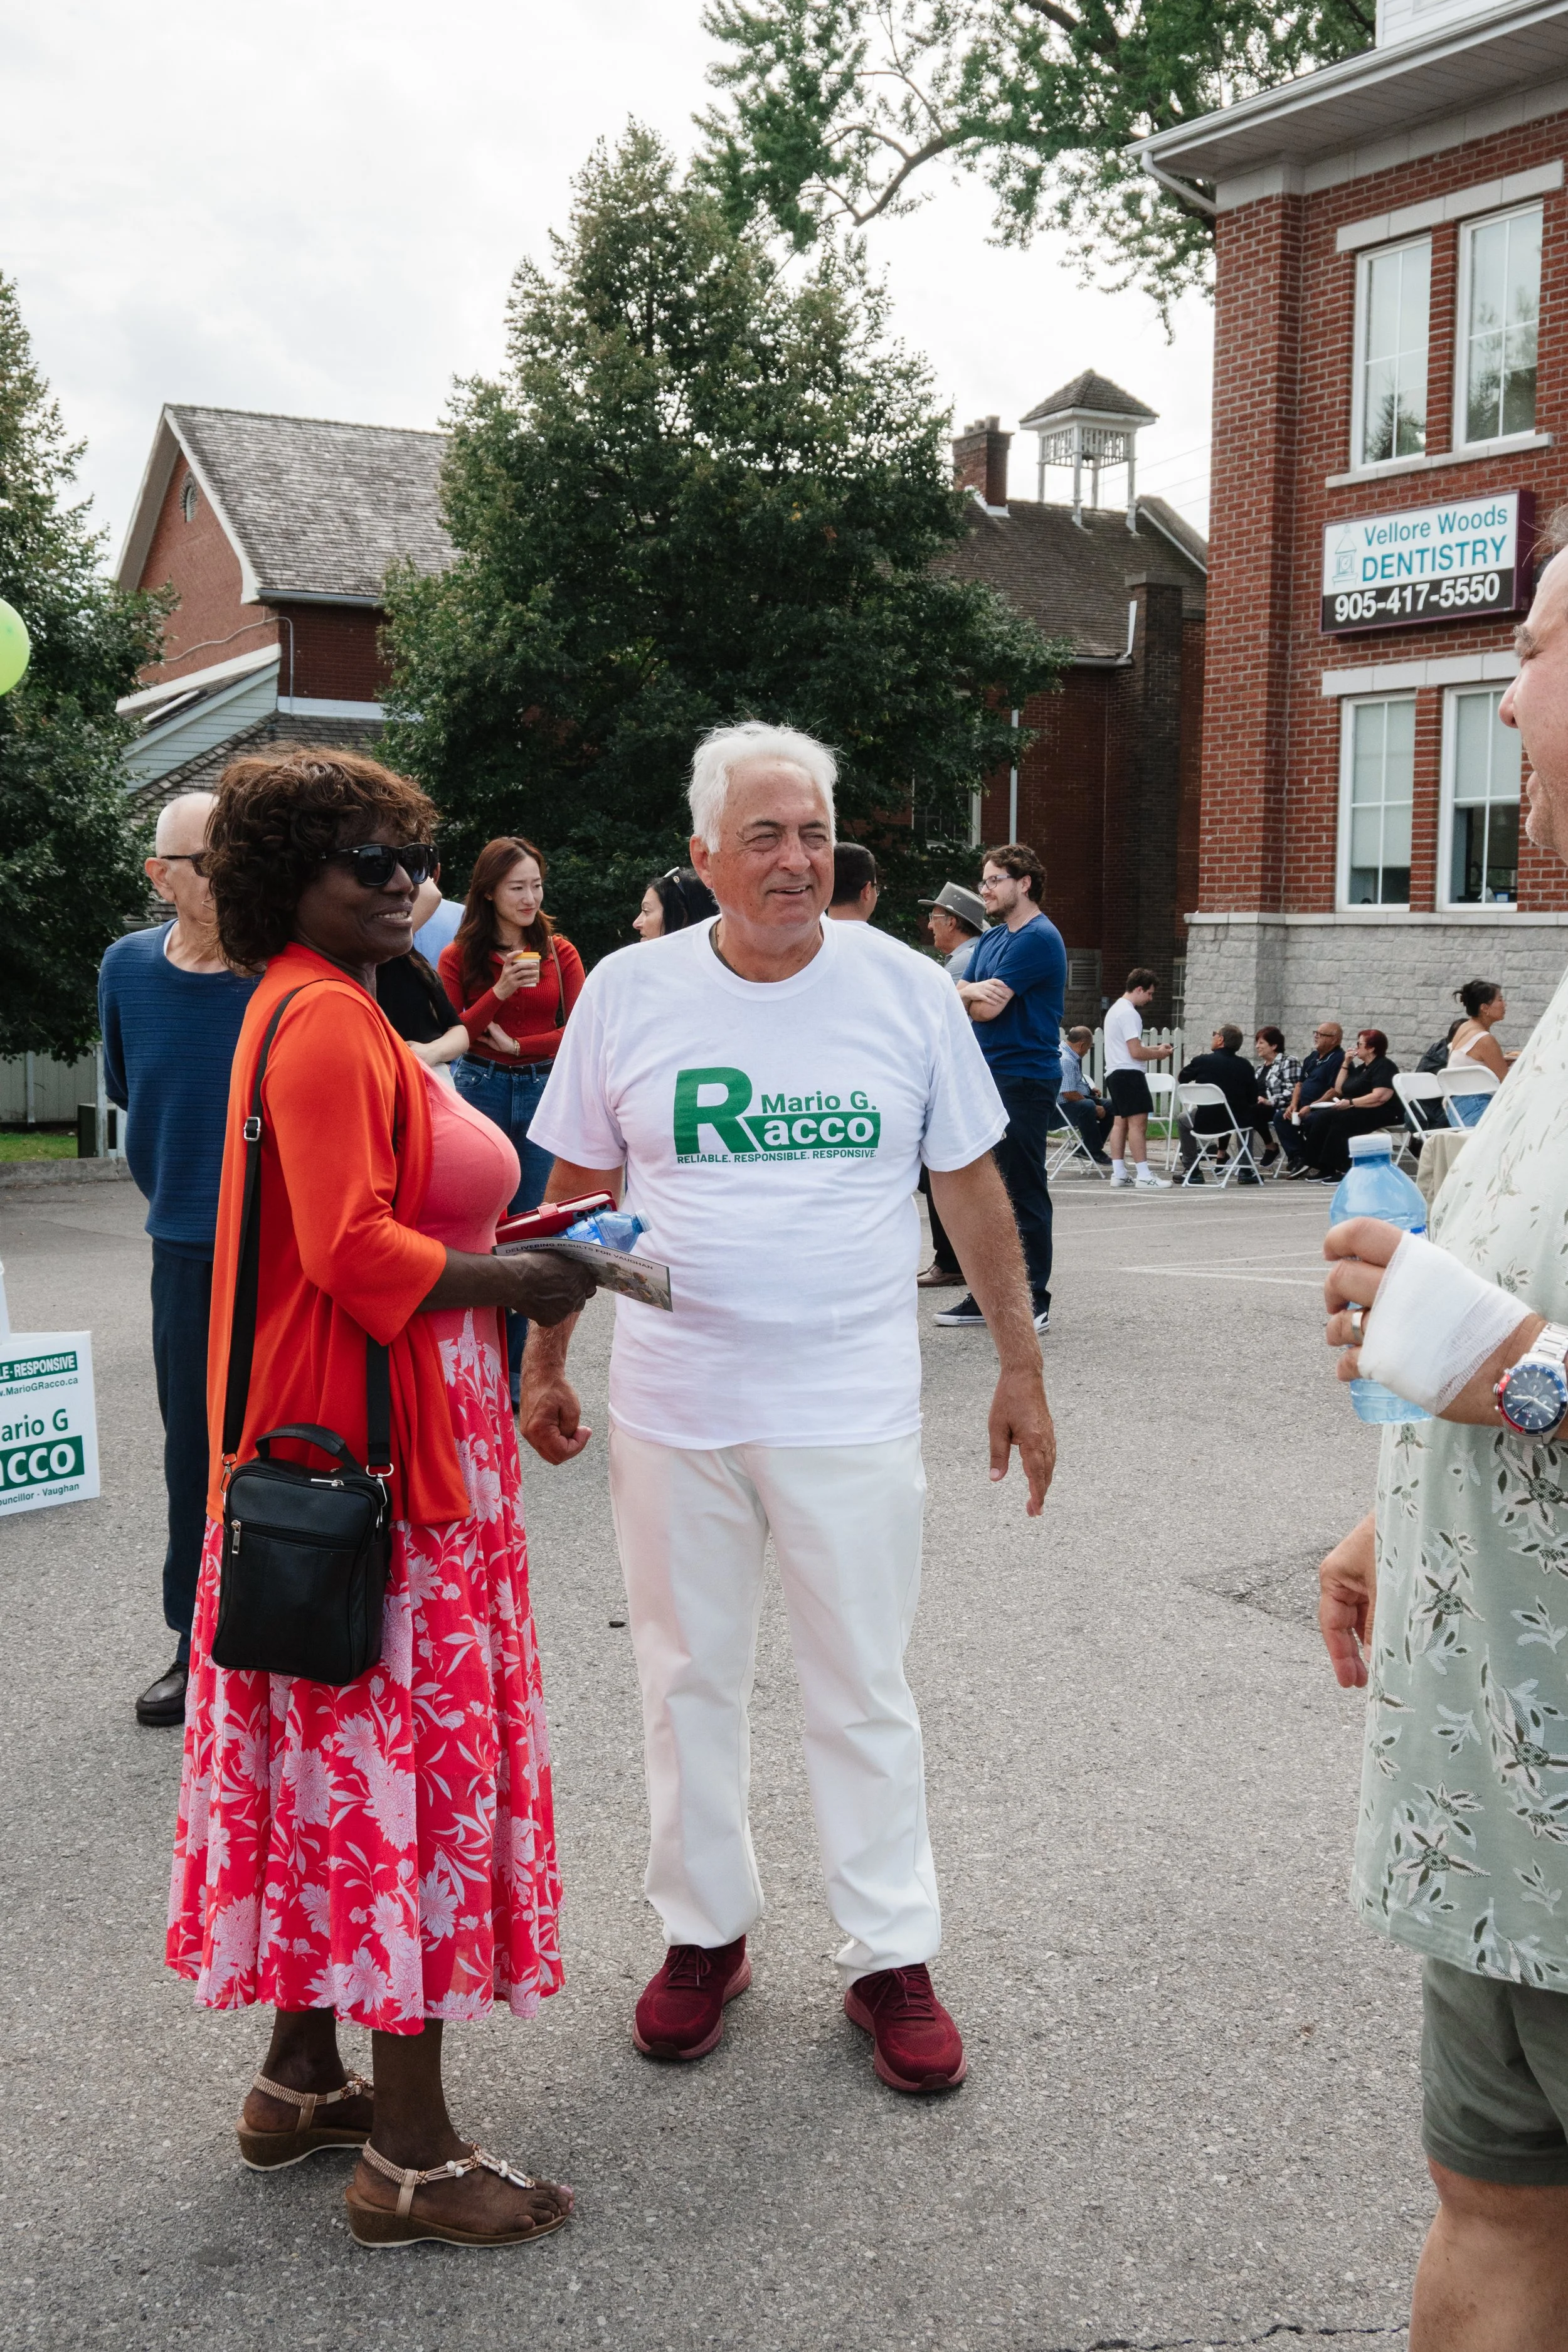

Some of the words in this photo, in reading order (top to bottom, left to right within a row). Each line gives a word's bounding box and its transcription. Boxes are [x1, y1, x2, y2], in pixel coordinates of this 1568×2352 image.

[1364, 521, 1431, 546] Vellore
[1438, 504, 1508, 534] Woods
[1362, 534, 1508, 582] DENTISTRY
[1335, 572, 1500, 622] 905-417-5550
[761, 1091, 840, 1114] Mario
[850, 1090, 877, 1110] G.
[677, 1154, 731, 1164] RELIABLE.
[734, 1151, 810, 1163] RESPONSIBLE.
[812, 1149, 877, 1160] RESPONSIVE.
[505, 1242, 555, 1254] DELIVERING
[557, 1243, 593, 1252] RESULTS
[595, 1249, 613, 1257] FOR
[613, 1254, 654, 1270] VAUGHAN
[52, 1408, 68, 1432] G
[0, 1443, 76, 1487] cco
[42, 1483, 79, 1496] Vaughan
